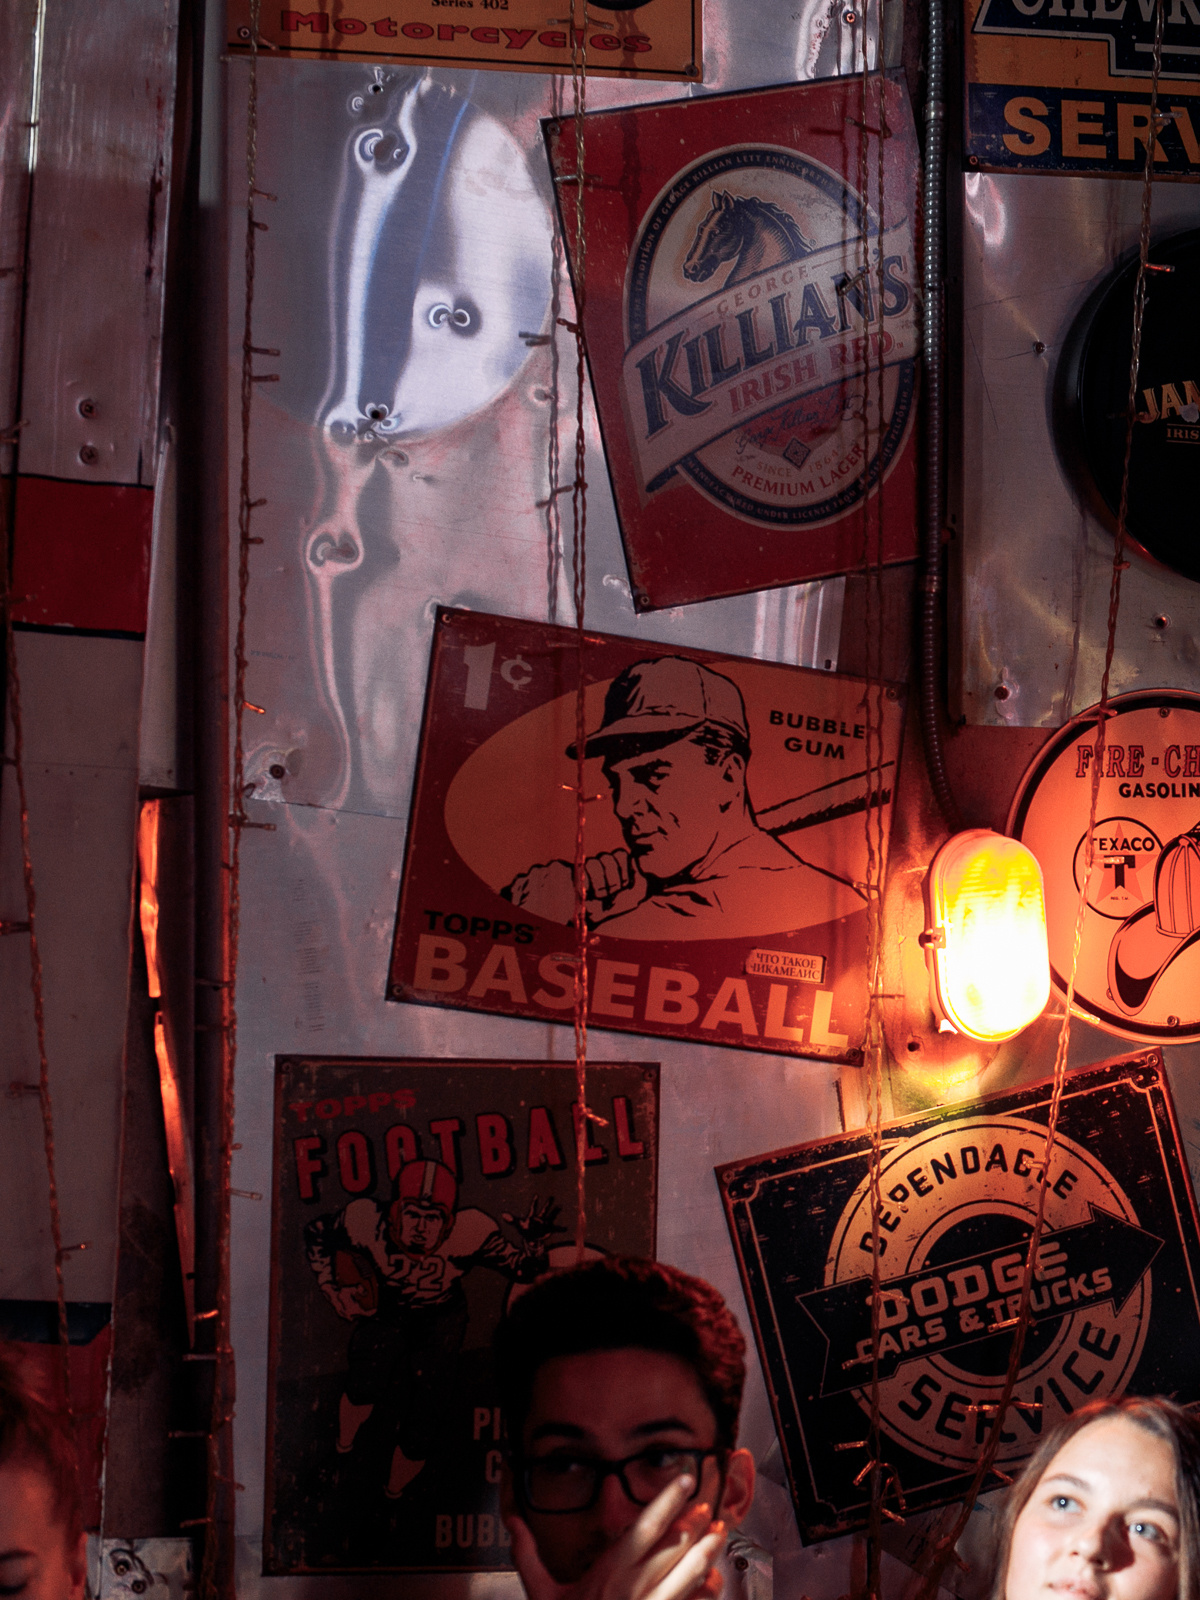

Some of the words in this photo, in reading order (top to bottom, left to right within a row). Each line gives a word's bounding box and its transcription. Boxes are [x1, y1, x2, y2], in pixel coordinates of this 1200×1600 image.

[280, 10, 653, 53] Motorcycles
[692, 157, 733, 182] KILLIAN
[716, 265, 810, 315] GEORGE
[635, 248, 908, 439] KILLIAN'S
[728, 359, 819, 415] IRISH
[829, 331, 893, 368] RED
[731, 465, 816, 496] PREMIUM
[818, 443, 866, 489] LAGER
[757, 461, 792, 478] SINCE
[768, 709, 866, 740] BUBBLE
[783, 736, 846, 761] GUM
[423, 909, 537, 945] TOPPS
[756, 952, 780, 965] ЧТО
[781, 955, 817, 969] ТАКОЕ
[412, 932, 850, 1049] BASEBALL
[288, 1088, 418, 1122] TOPPS
[293, 1095, 648, 1203] FOOTBALL
[859, 1143, 1079, 1258] DEPENDABLE
[865, 1240, 1069, 1329] DODGE
[854, 1316, 948, 1361] CARS
[958, 1307, 986, 1334] &
[985, 1266, 1114, 1325] TRUCKS
[898, 1320, 1121, 1444] SERVICE
[434, 1513, 513, 1550] BUBB
